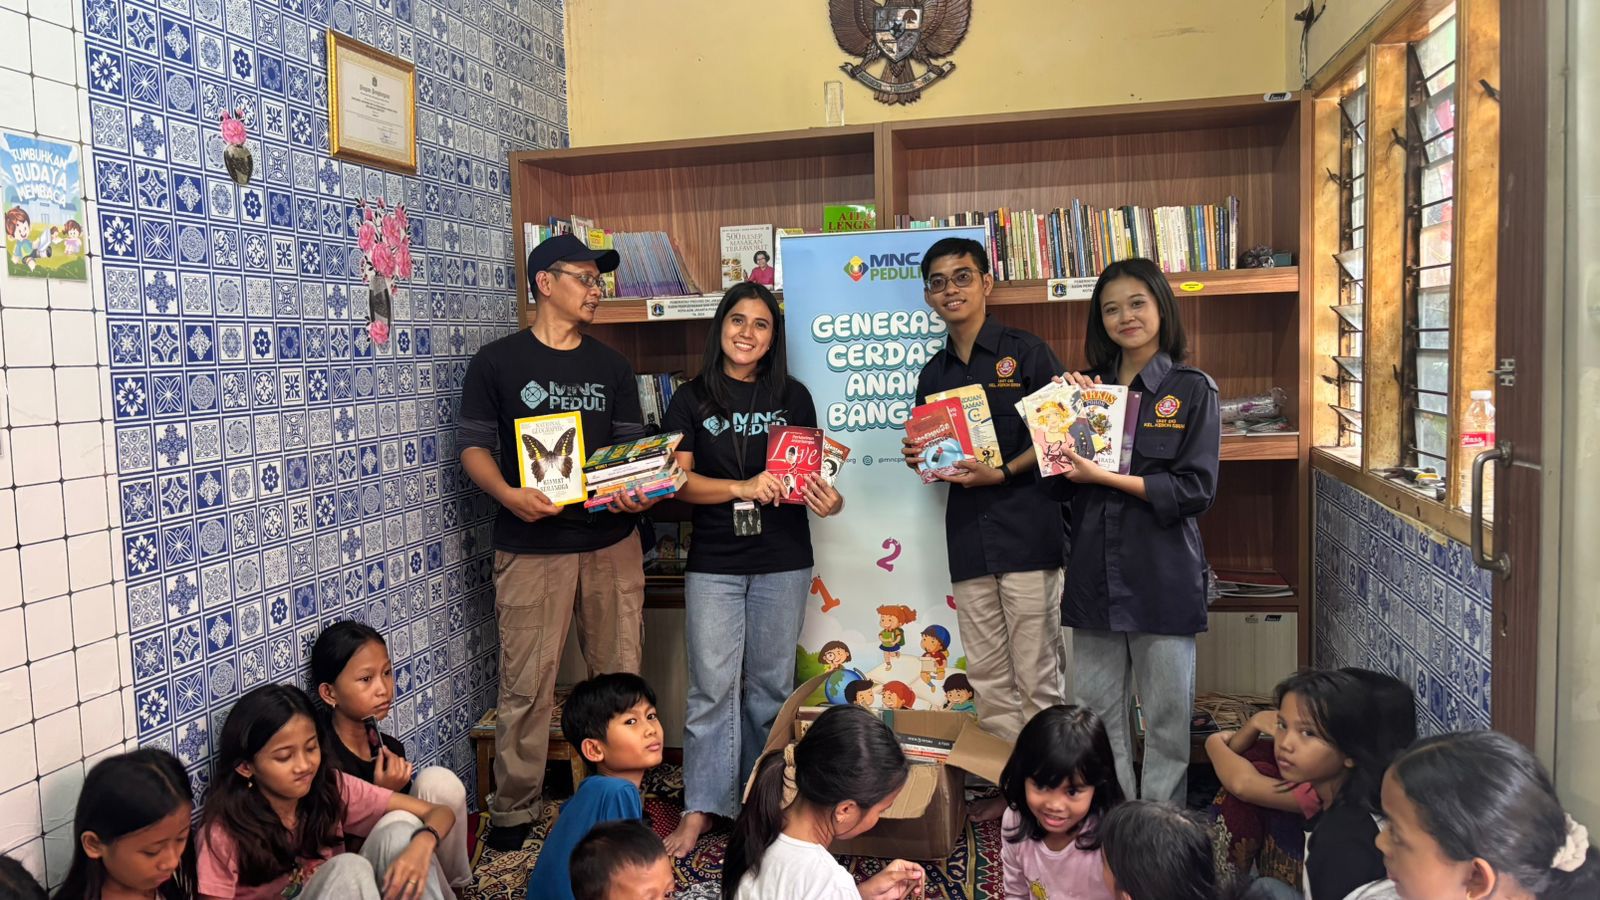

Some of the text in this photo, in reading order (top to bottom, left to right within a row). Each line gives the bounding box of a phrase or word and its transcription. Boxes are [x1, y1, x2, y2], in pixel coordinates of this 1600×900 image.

[12, 147, 68, 170] TUMBUHKAN
[12, 163, 67, 191] BUDAYA
[16, 183, 67, 208] MEMBACA
[726, 232, 741, 241] 500
[870, 253, 920, 267] MNC
[812, 310, 947, 342] GENERAS
[827, 339, 944, 371] CERDAS
[549, 380, 605, 397] MNC
[846, 371, 919, 400] ANAK
[549, 395, 606, 411] PEDULI
[827, 401, 908, 431] BANG
[733, 409, 788, 424] MNC
[876, 538, 902, 572] 2
[810, 574, 841, 613] 1
